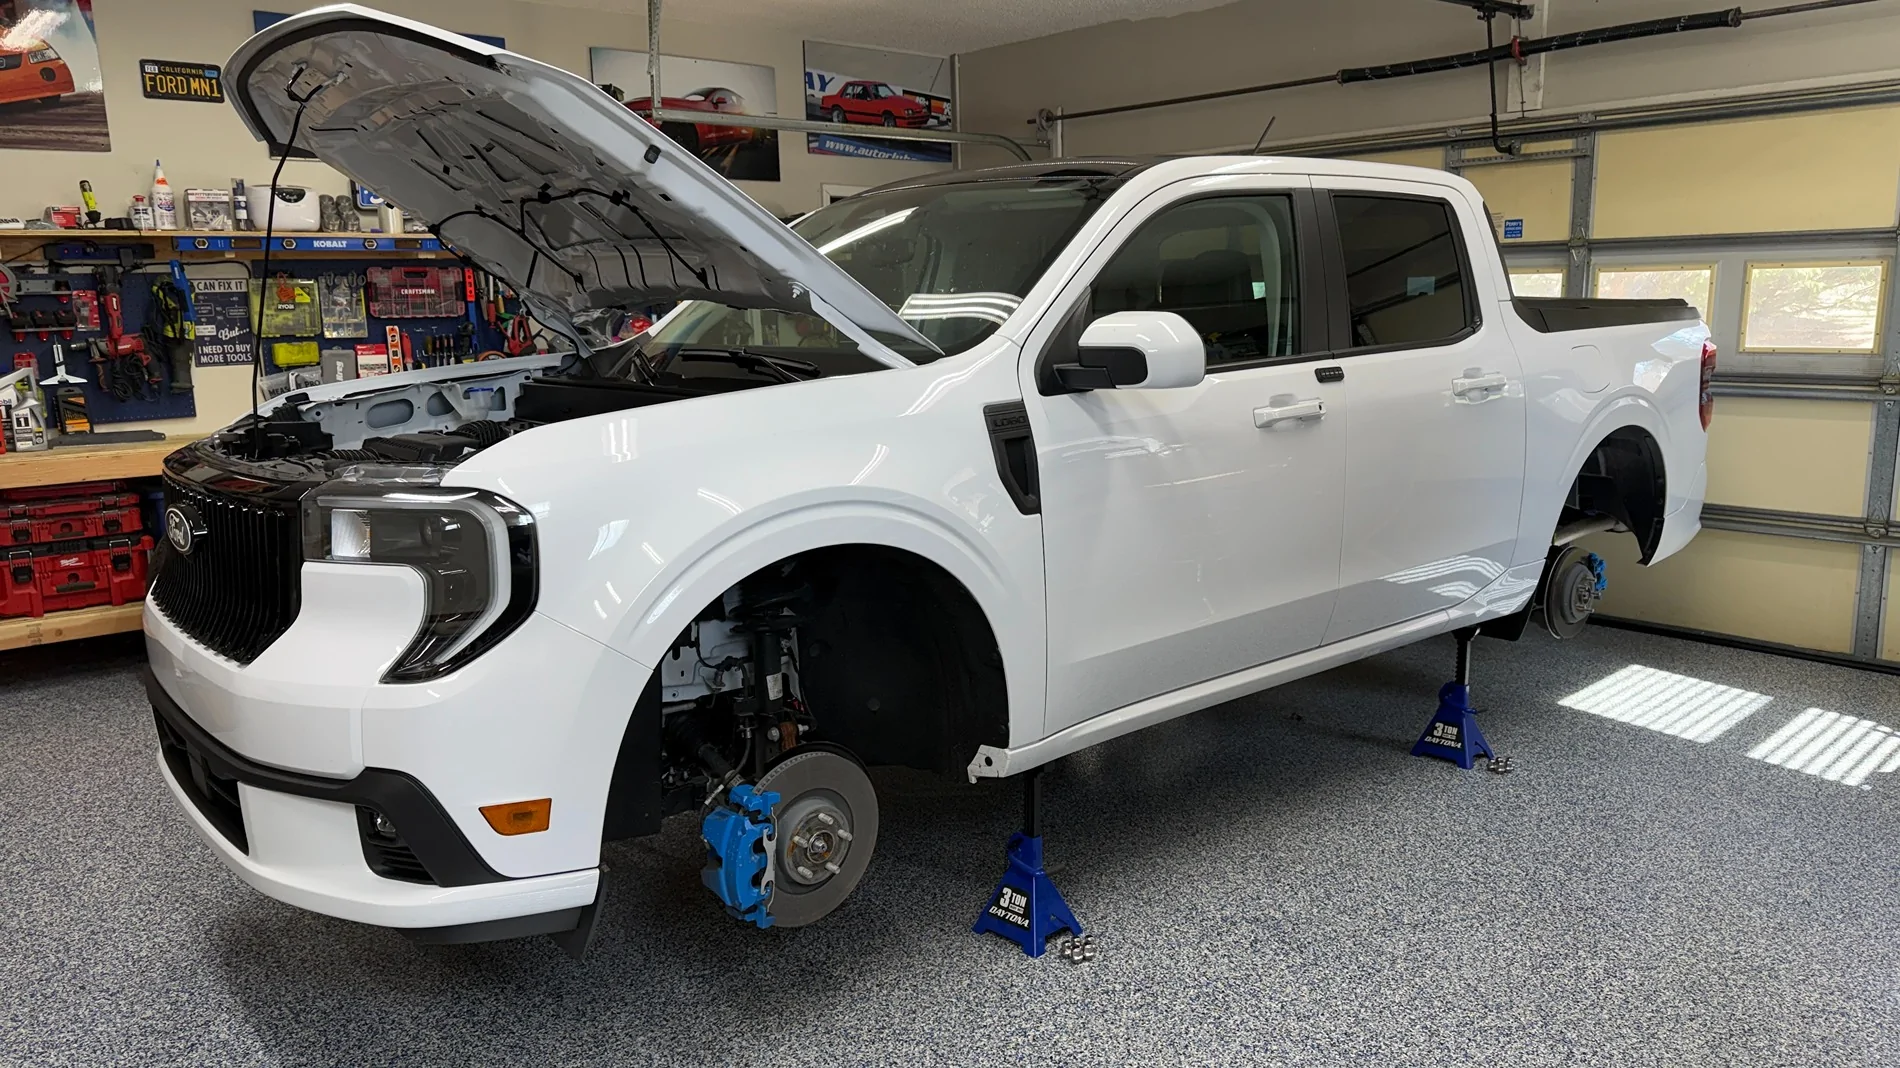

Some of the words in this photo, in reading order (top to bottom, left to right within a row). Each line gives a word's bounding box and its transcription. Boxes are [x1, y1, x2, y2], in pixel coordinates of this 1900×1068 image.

[161, 66, 203, 75] CALIFORNIA
[145, 74, 187, 95] FORD
[190, 77, 221, 97] MN1
[313, 240, 347, 248] KOBALT
[197, 281, 215, 291] CAN
[218, 281, 232, 291] FIX
[235, 281, 243, 290] IT
[198, 346, 202, 354] I
[203, 345, 223, 354] NEED
[224, 344, 235, 353] TO
[236, 344, 251, 352] BUY
[201, 355, 224, 364] MORE
[226, 353, 252, 362] TOOLS
[305, 380, 320, 388] PRO
[19, 417, 26, 427] 1
[1433, 722, 1444, 737] 3
[1444, 725, 1458, 736] TON
[1424, 735, 1462, 749] DAYTONA
[1000, 887, 1012, 908] 3
[1011, 892, 1027, 908] TON
[989, 906, 1030, 928] DAYTONA
